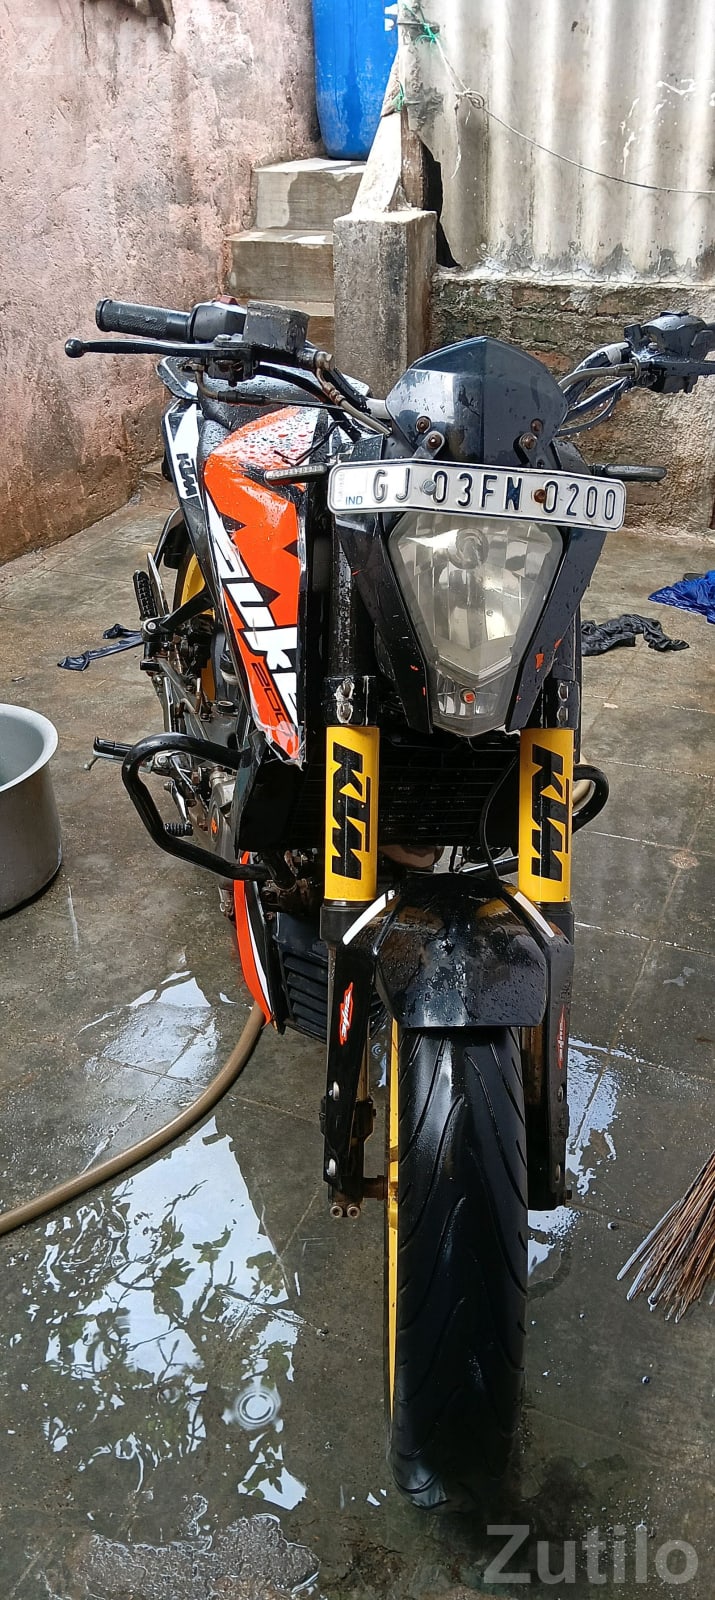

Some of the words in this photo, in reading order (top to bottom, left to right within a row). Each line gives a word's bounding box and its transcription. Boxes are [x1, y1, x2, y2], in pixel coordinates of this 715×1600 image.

[176, 453, 198, 497] KTM
[345, 495, 364, 506] IND
[371, 467, 411, 504] GJ
[541, 480, 616, 522] 0200
[331, 742, 371, 880] KTM
[531, 743, 570, 882] KTM
